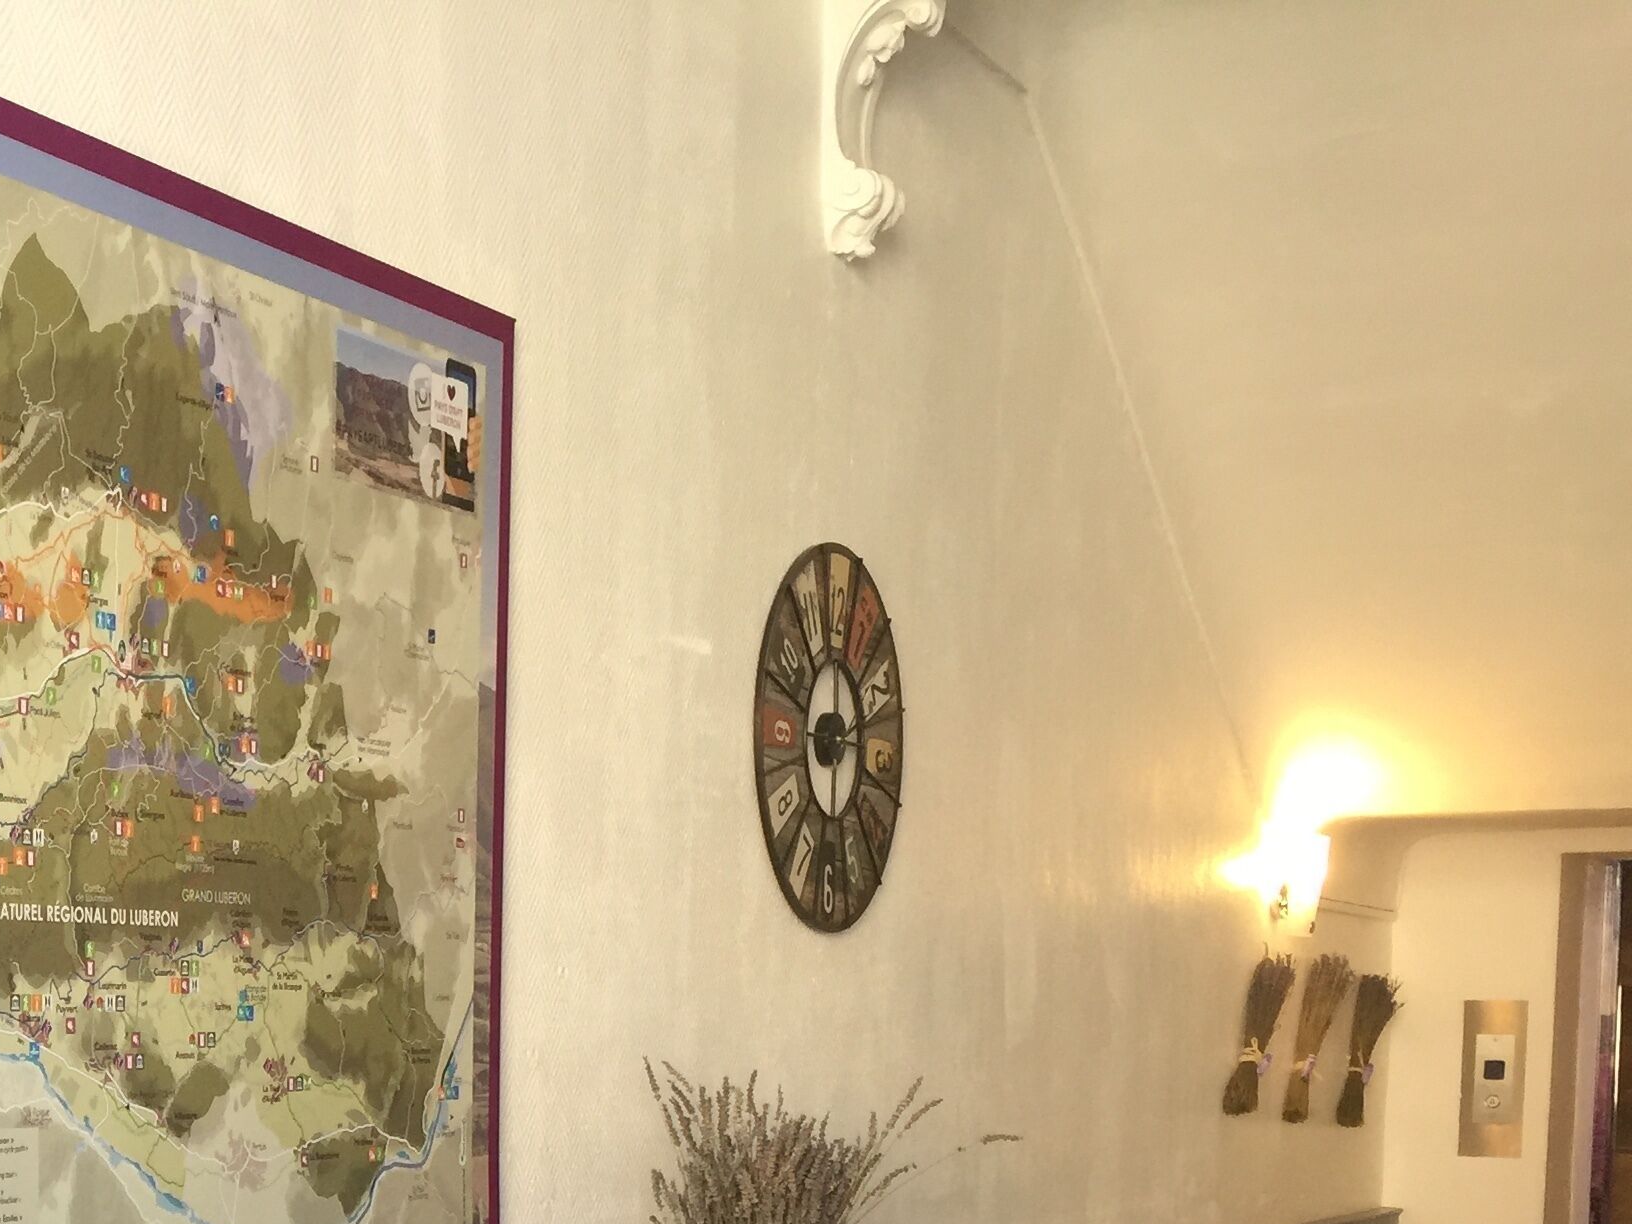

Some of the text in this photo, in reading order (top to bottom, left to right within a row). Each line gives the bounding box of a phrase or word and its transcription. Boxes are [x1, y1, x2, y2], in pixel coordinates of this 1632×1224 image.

[181, 888, 251, 905] GRAND LUBERON
[47, 900, 108, 924] RÉGIONAL
[111, 908, 127, 925] DU
[130, 908, 179, 927] LUBERON
